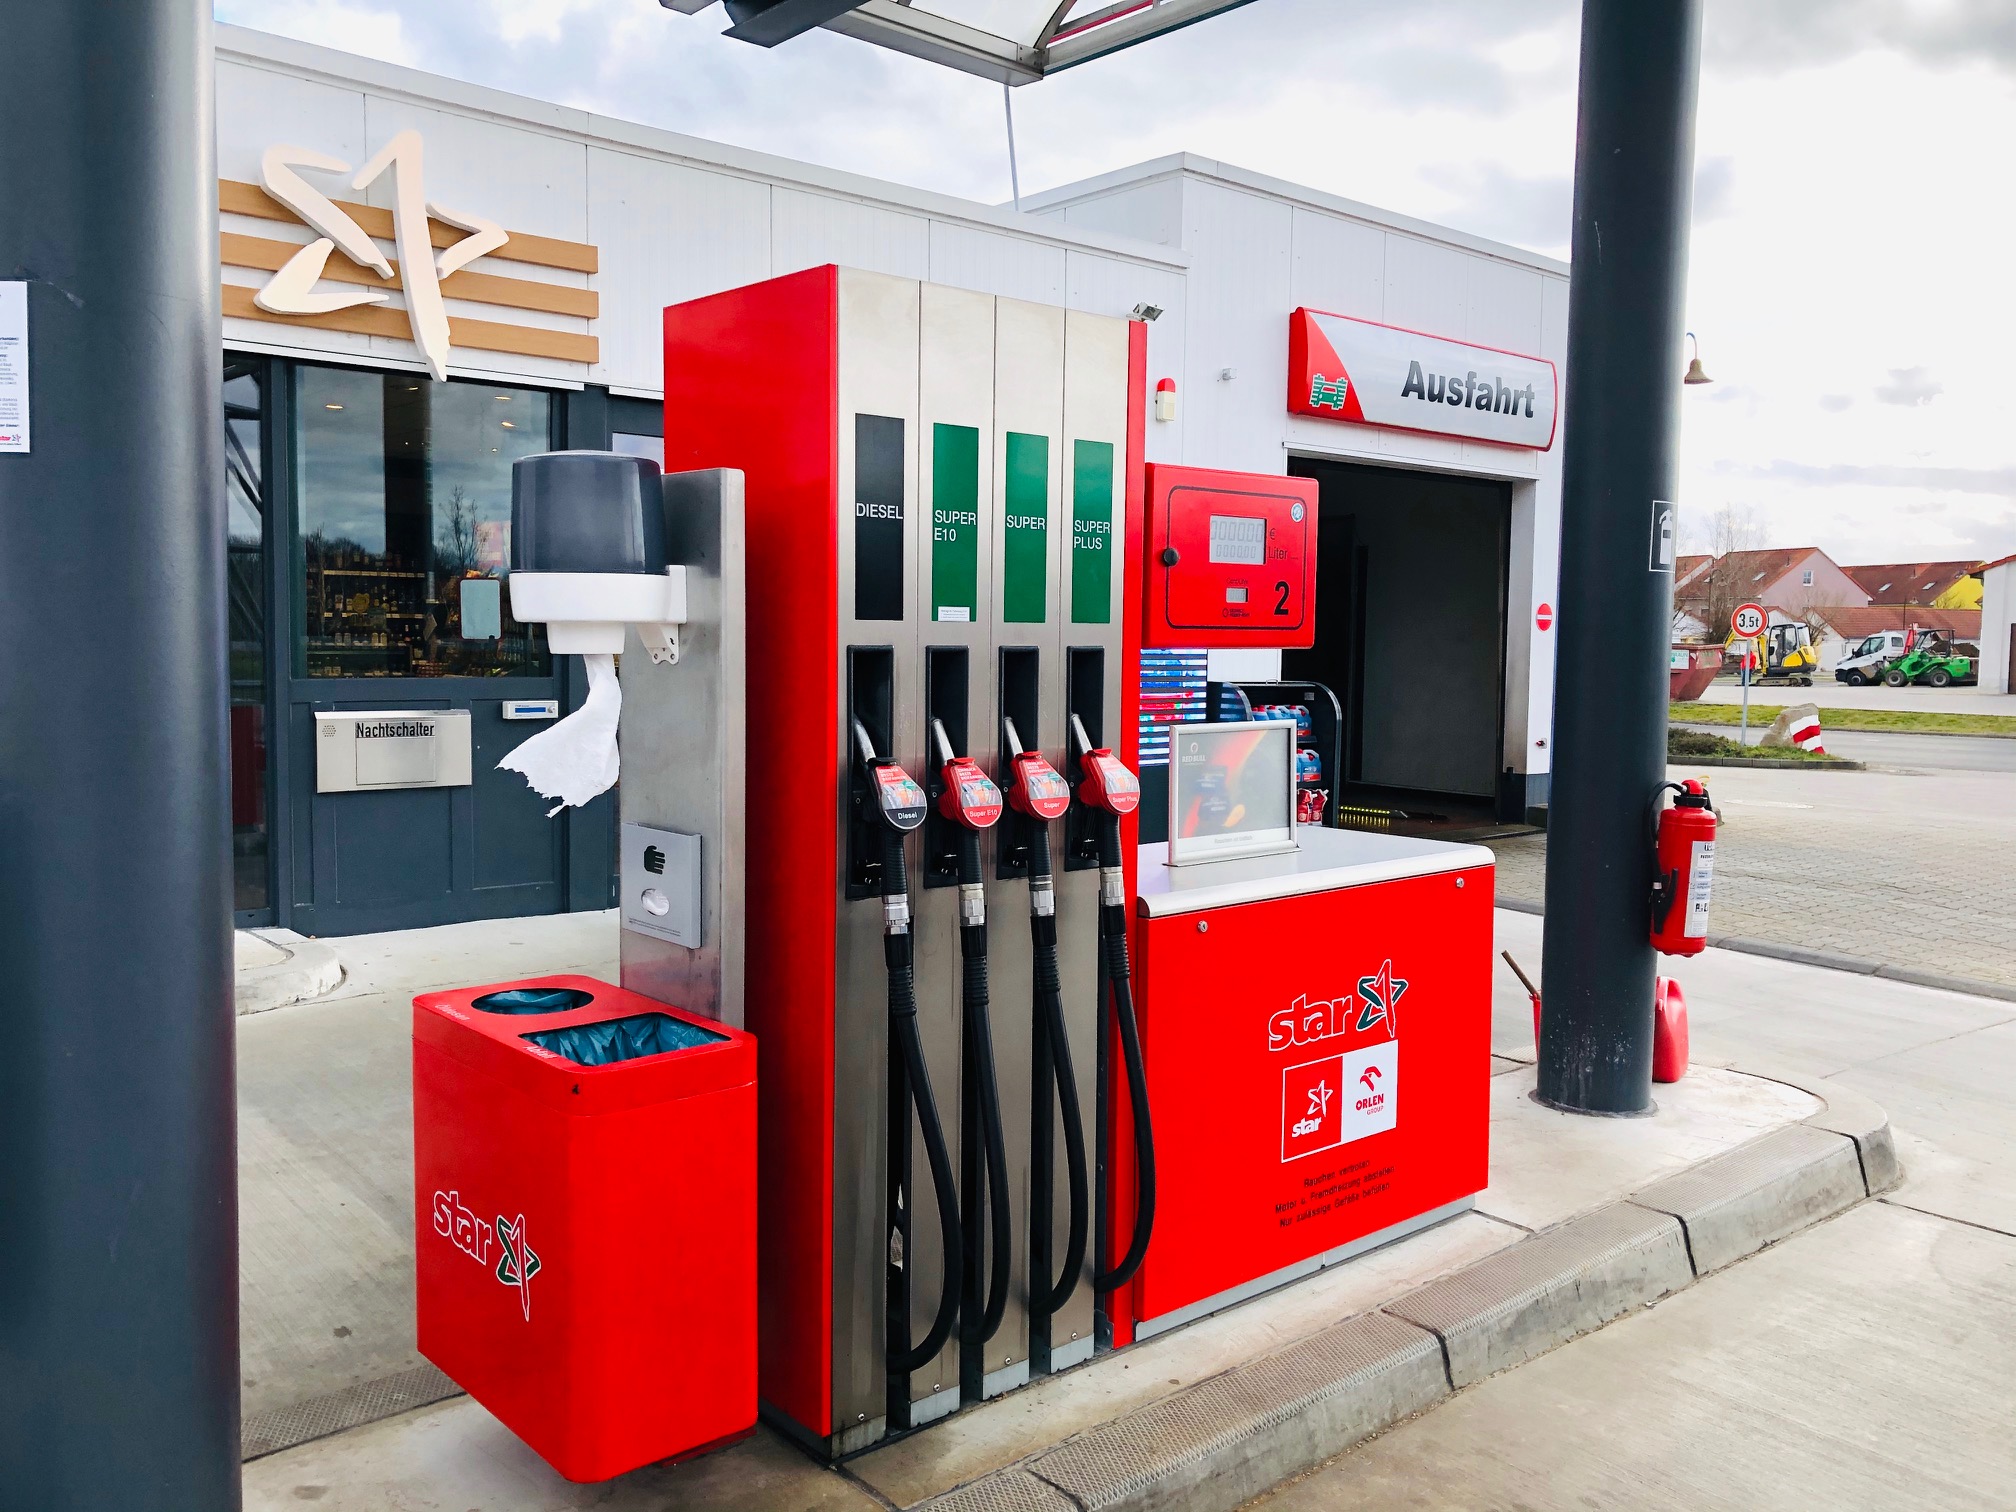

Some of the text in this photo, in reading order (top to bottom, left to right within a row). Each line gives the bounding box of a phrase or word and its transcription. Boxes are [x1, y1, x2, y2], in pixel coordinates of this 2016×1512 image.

[1401, 360, 1535, 418] Ausfahrt
[856, 502, 904, 519] DIESEL
[934, 510, 977, 526] SUPER
[1006, 515, 1046, 530] SUPER
[1074, 520, 1110, 534] SUPER
[934, 528, 957, 542] E10
[1074, 537, 1103, 550] PLUS
[1268, 546, 1288, 560] Liter
[1274, 580, 1290, 615] 2
[356, 721, 435, 738] Nachtschalter
[897, 812, 918, 820] Diesel
[970, 810, 986, 818] Super
[1268, 993, 1353, 1051] star
[1355, 1093, 1384, 1111] ORLEN
[1366, 1105, 1384, 1116] GROUP
[1291, 1116, 1323, 1138] star
[1303, 1171, 1336, 1187] Rauchen
[1275, 1200, 1297, 1214] Motor
[434, 1190, 492, 1266] star
[1280, 1217, 1292, 1228] Nur
